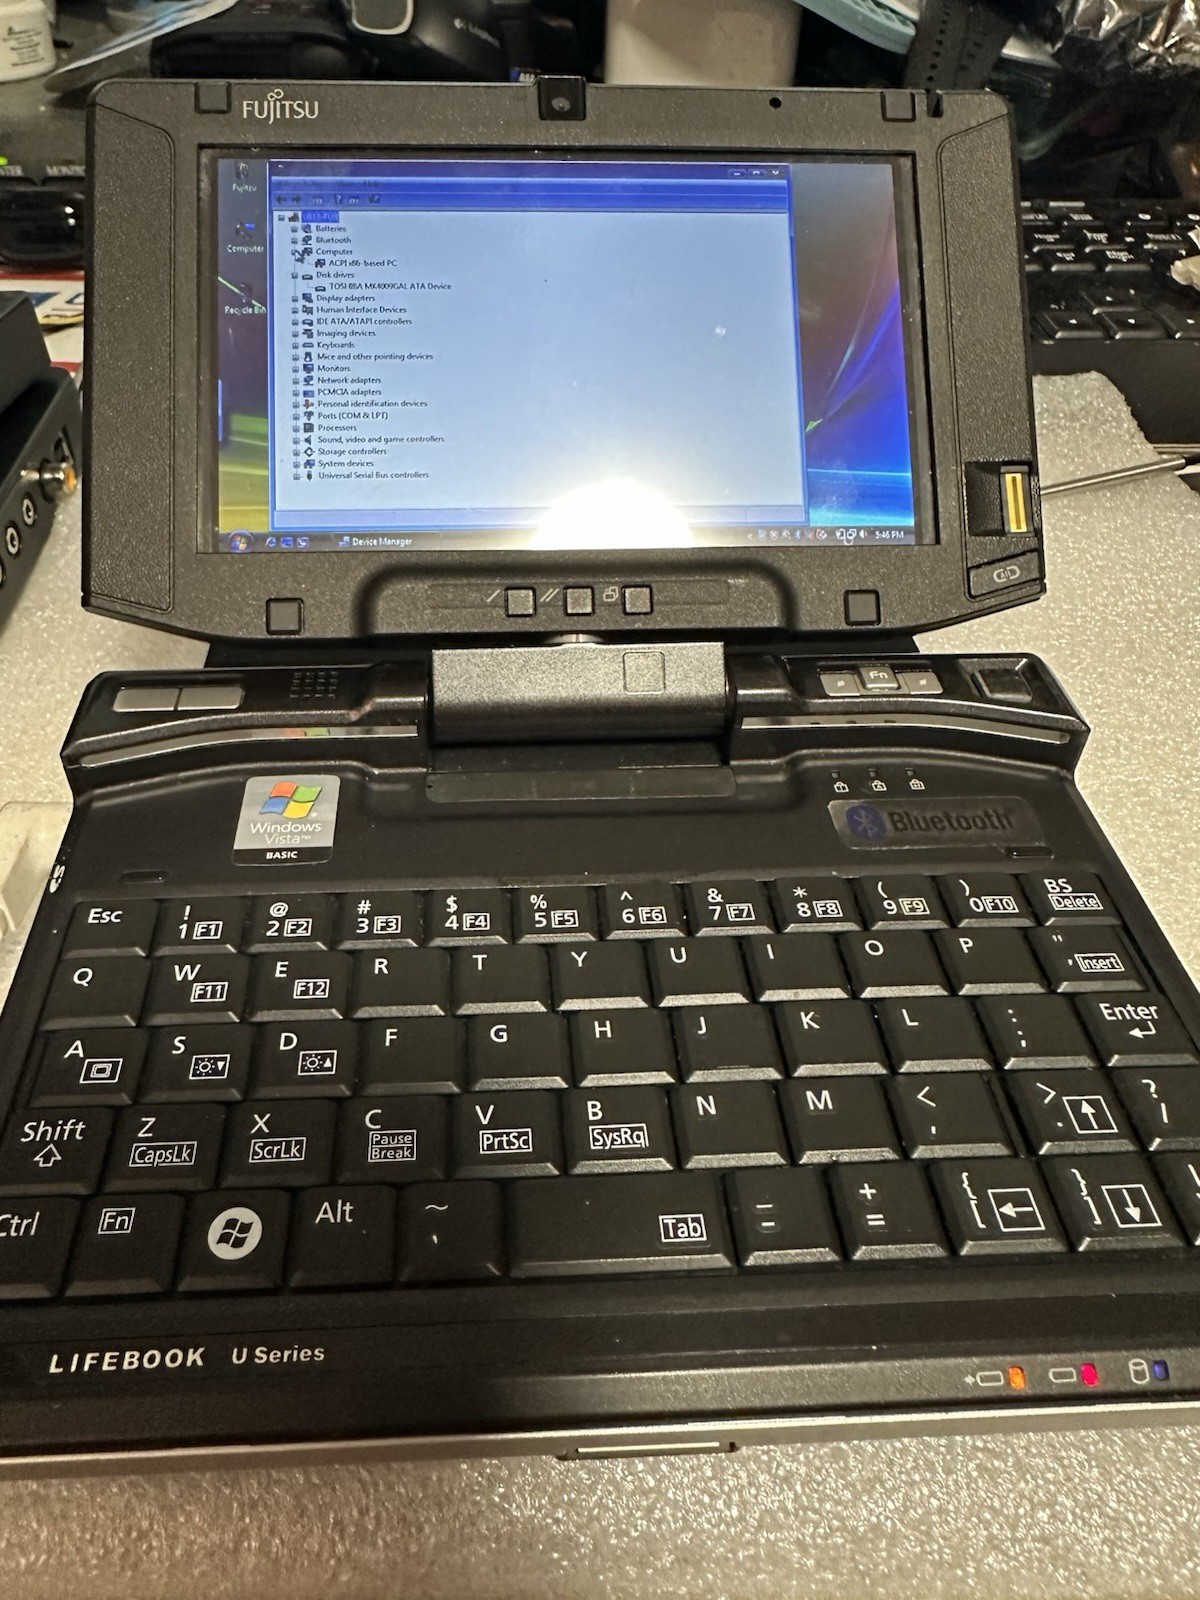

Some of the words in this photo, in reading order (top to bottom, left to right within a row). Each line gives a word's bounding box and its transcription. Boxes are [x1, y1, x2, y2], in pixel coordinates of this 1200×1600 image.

[243, 99, 319, 124] FUJITSU
[227, 245, 264, 253] Computer
[316, 248, 353, 256] Computer
[316, 295, 343, 303] Display
[344, 295, 376, 303] adapters
[316, 330, 347, 338] Imaging
[317, 341, 355, 350] Keyboards
[374, 353, 405, 361] pointing
[350, 377, 381, 385] adapters
[350, 389, 382, 397] adapters
[338, 412, 361, 420] (COM
[371, 412, 389, 420] LPT)
[318, 436, 344, 444] Sound,
[406, 435, 445, 443] controllers
[318, 448, 347, 457] Storage
[318, 460, 345, 469] System
[352, 537, 379, 546] Device
[379, 537, 413, 547] Manager
[875, 531, 890, 539] 5:46
[891, 531, 904, 539] PM
[869, 671, 889, 680] Fn
[250, 821, 322, 834] Windows
[887, 808, 1014, 832] Bluetooth
[266, 851, 298, 860] BASIC
[1043, 879, 1072, 893] BS
[797, 903, 811, 917] 8
[816, 902, 840, 916] F8
[883, 900, 897, 915] 9
[902, 899, 927, 913] F9
[969, 897, 984, 912] 0
[985, 897, 1016, 912] F10
[1053, 895, 1099, 910] Delete
[88, 908, 123, 924] Esc
[534, 912, 547, 927] 5
[554, 912, 576, 926] F5
[622, 908, 635, 923] 6
[641, 909, 663, 923] F6
[709, 906, 721, 920] 7
[729, 905, 751, 920] F7
[266, 921, 279, 936] 2
[286, 920, 309, 935] F2
[356, 918, 369, 933] 3
[376, 917, 398, 932] F3
[445, 916, 459, 930] 4
[465, 915, 487, 929] F4
[179, 924, 188, 939] 1
[195, 923, 219, 938] F1
[766, 944, 774, 959] I
[864, 941, 884, 956] O
[959, 938, 974, 953] P
[473, 954, 487, 970] T
[571, 951, 587, 967] Y
[670, 947, 687, 963] U
[1079, 956, 1120, 970] Insert
[174, 964, 201, 981] W
[275, 962, 289, 978] E
[374, 959, 389, 974] R
[73, 968, 93, 987] Q
[194, 985, 223, 999] F11
[296, 981, 326, 996] F12
[902, 1009, 919, 1026] L
[1099, 1003, 1158, 1021] Enter
[594, 1020, 612, 1038] H
[697, 1016, 707, 1035] J
[800, 1012, 820, 1030] K
[385, 1029, 397, 1046] F
[490, 1024, 508, 1042] G
[64, 1040, 85, 1058] A
[172, 1036, 186, 1054] S
[279, 1033, 298, 1050] D
[696, 1096, 717, 1115] N
[805, 1090, 833, 1110] M
[475, 1105, 495, 1124] V
[587, 1101, 603, 1120] B
[137, 1117, 156, 1137] Z
[251, 1113, 271, 1134] X
[365, 1109, 383, 1129] C
[20, 1119, 86, 1142] Shift
[593, 1127, 645, 1149] SysRq
[372, 1133, 412, 1145] Pause
[483, 1132, 529, 1150] PrtSc
[133, 1145, 191, 1166] CapsLk
[253, 1140, 301, 1160] ScrLk
[372, 1147, 412, 1159] Break
[315, 1199, 354, 1223] Alt
[103, 1212, 130, 1230] Fn
[663, 1218, 701, 1239] Tab
[49, 1347, 205, 1373] LIFEBOOK
[231, 1347, 248, 1364] U
[254, 1344, 325, 1364] Series
